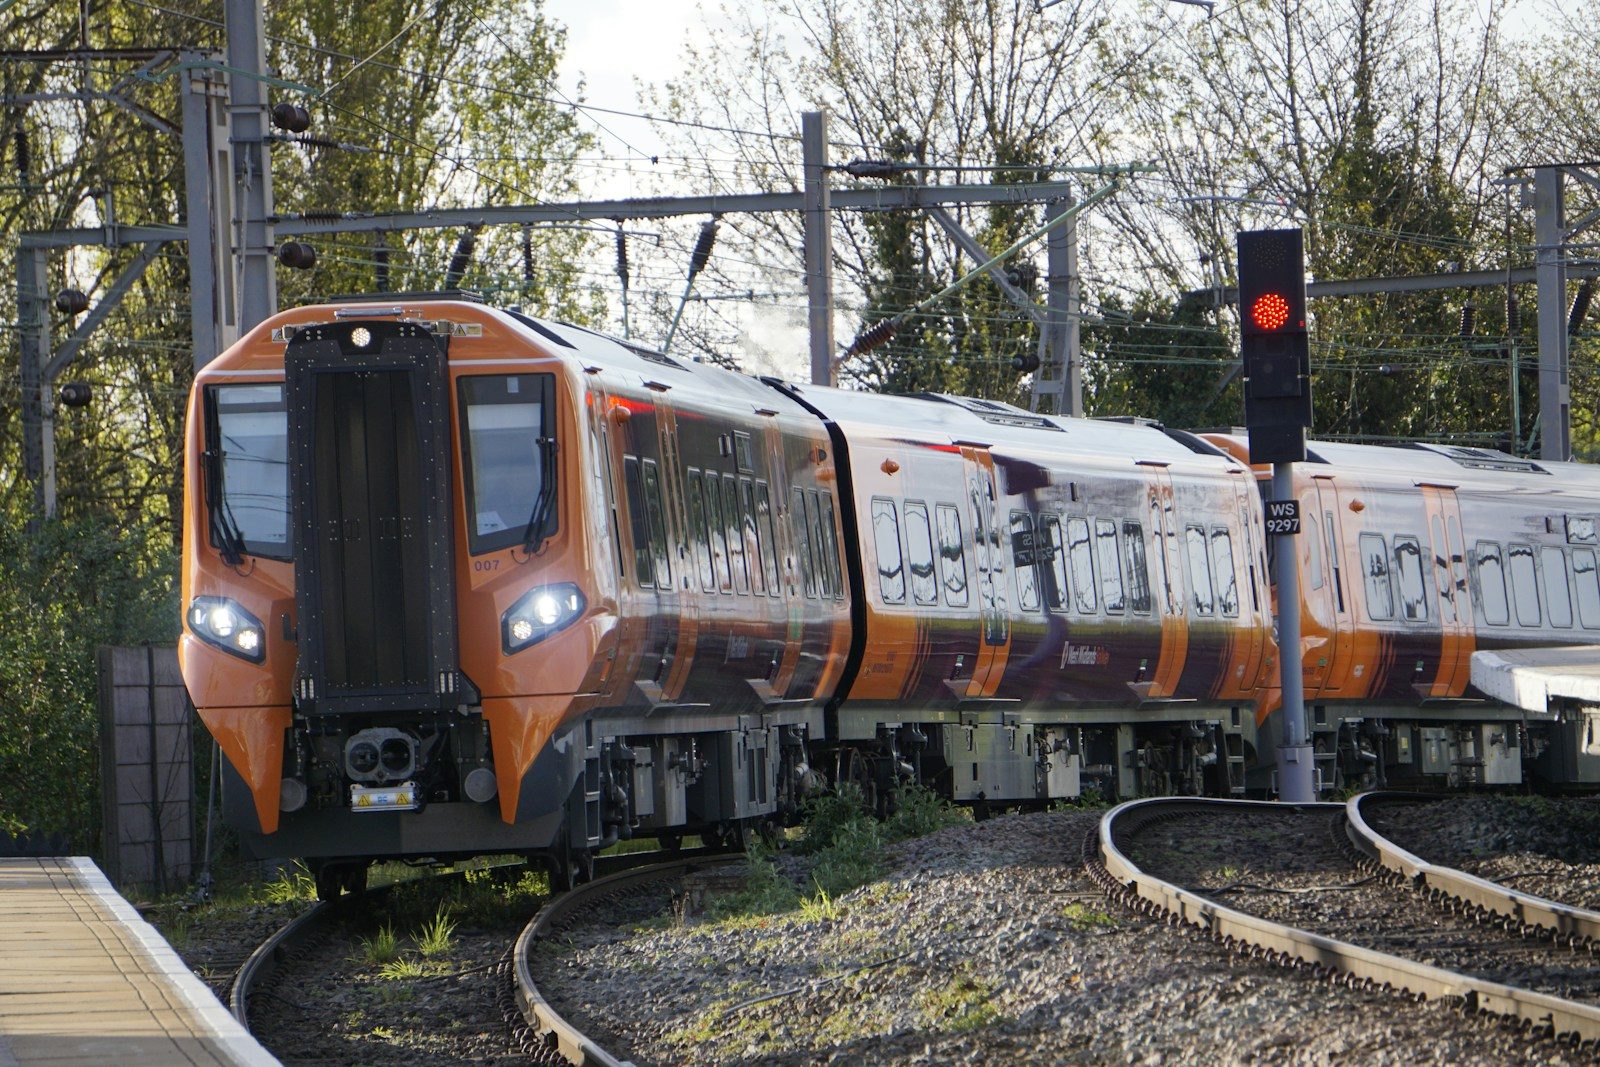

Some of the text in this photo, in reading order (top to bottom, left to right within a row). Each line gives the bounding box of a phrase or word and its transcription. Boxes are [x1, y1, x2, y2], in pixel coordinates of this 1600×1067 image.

[1270, 503, 1295, 516] WS
[1267, 518, 1300, 532] 9297
[474, 560, 500, 571] 007
